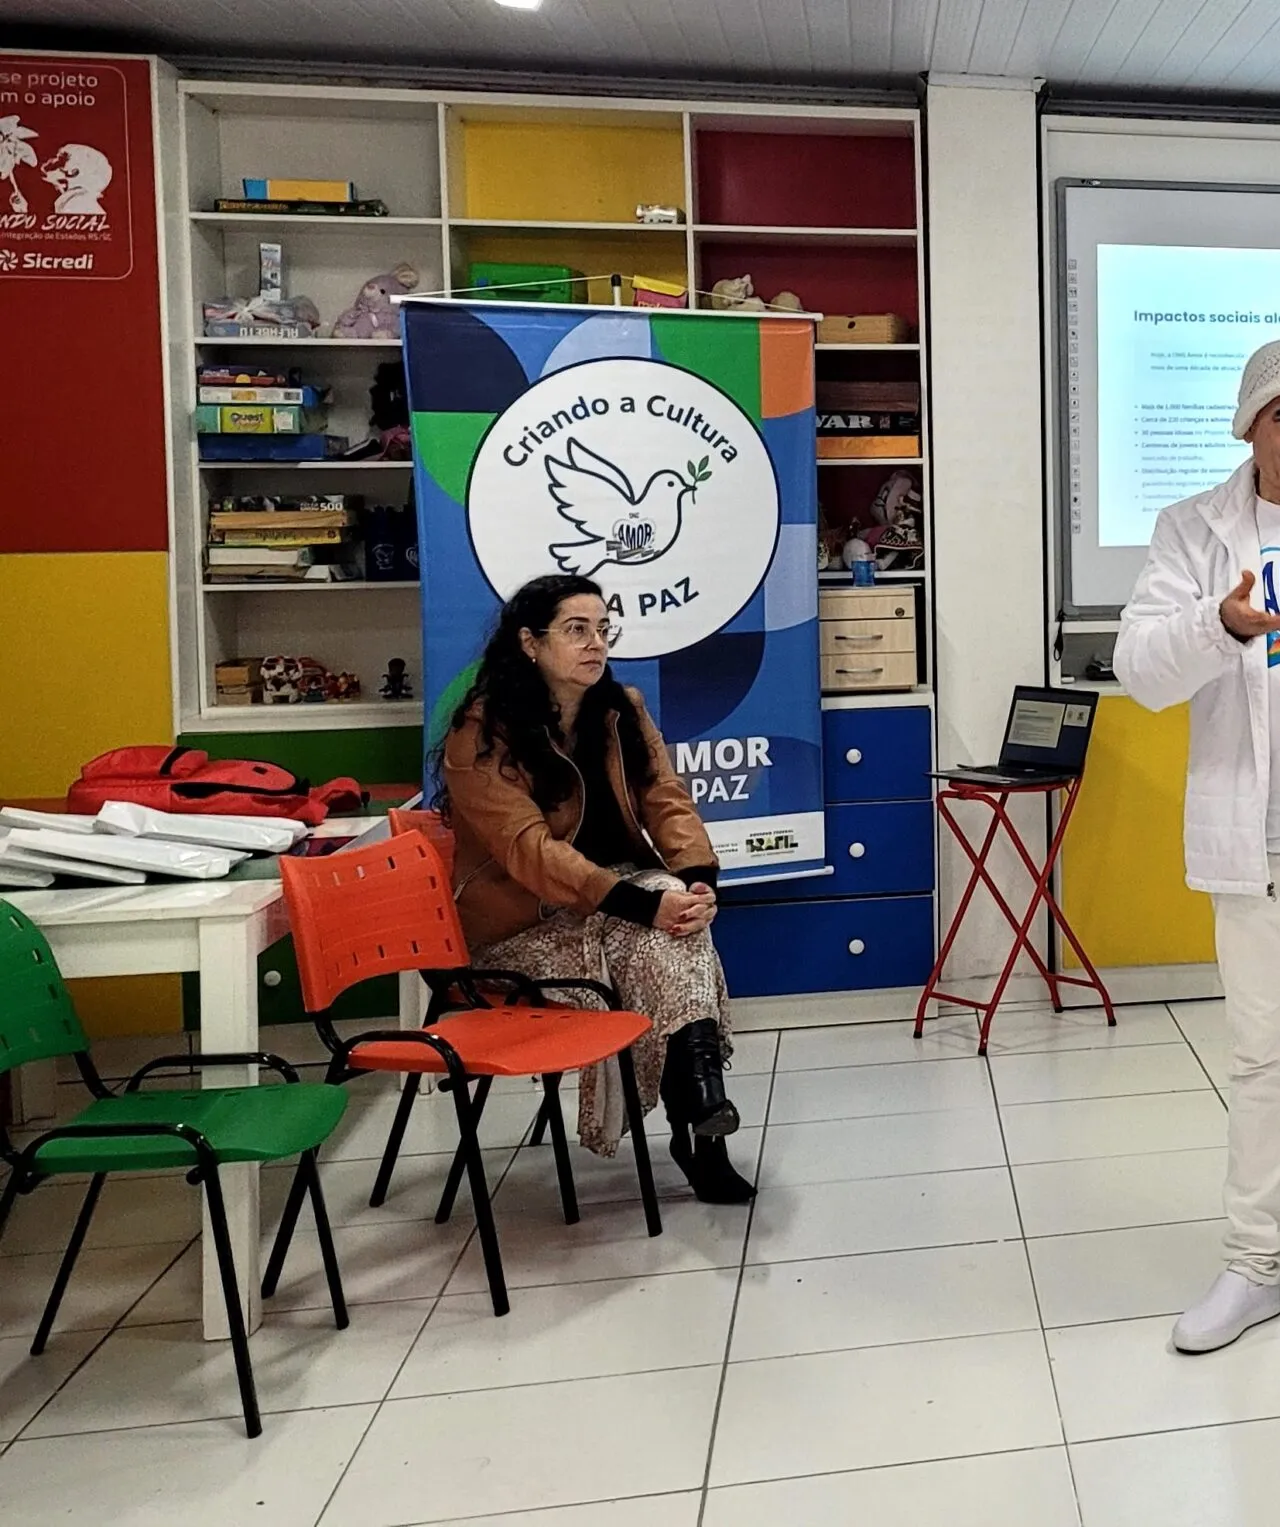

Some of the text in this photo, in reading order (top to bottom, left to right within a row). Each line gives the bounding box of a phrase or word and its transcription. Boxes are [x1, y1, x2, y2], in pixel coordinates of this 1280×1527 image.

[0, 71, 98, 89] se projeto
[24, 92, 36, 104] o
[41, 91, 96, 108] apoio
[0, 213, 111, 231] NDO SOCIAL
[22, 253, 94, 269] Sicredi
[1133, 310, 1206, 326] Impactos
[1209, 310, 1261, 323] sociais
[503, 395, 740, 468] Criando a Cultura
[320, 502, 344, 512] 500
[618, 522, 653, 551] AMOR
[606, 576, 700, 618] A PAZ
[676, 737, 773, 773] MOR
[691, 775, 750, 804] PAZ
